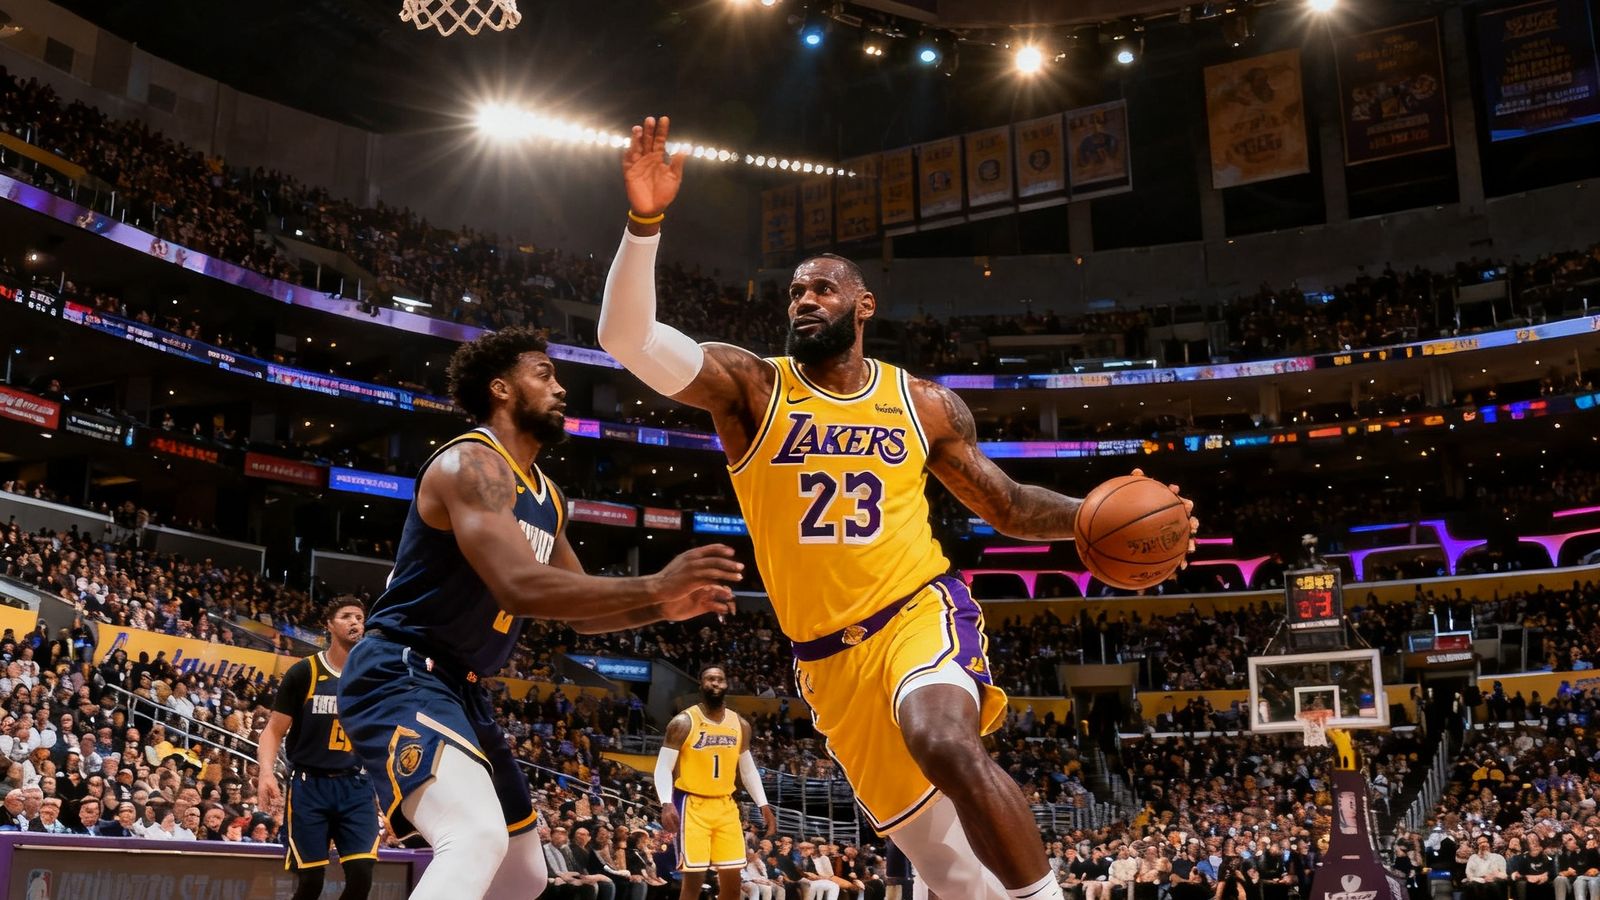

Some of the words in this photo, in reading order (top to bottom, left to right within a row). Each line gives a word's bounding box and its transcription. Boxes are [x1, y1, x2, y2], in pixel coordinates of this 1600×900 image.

[770, 412, 909, 466] LAKERS
[798, 470, 884, 544] 23
[712, 753, 721, 780] 1
